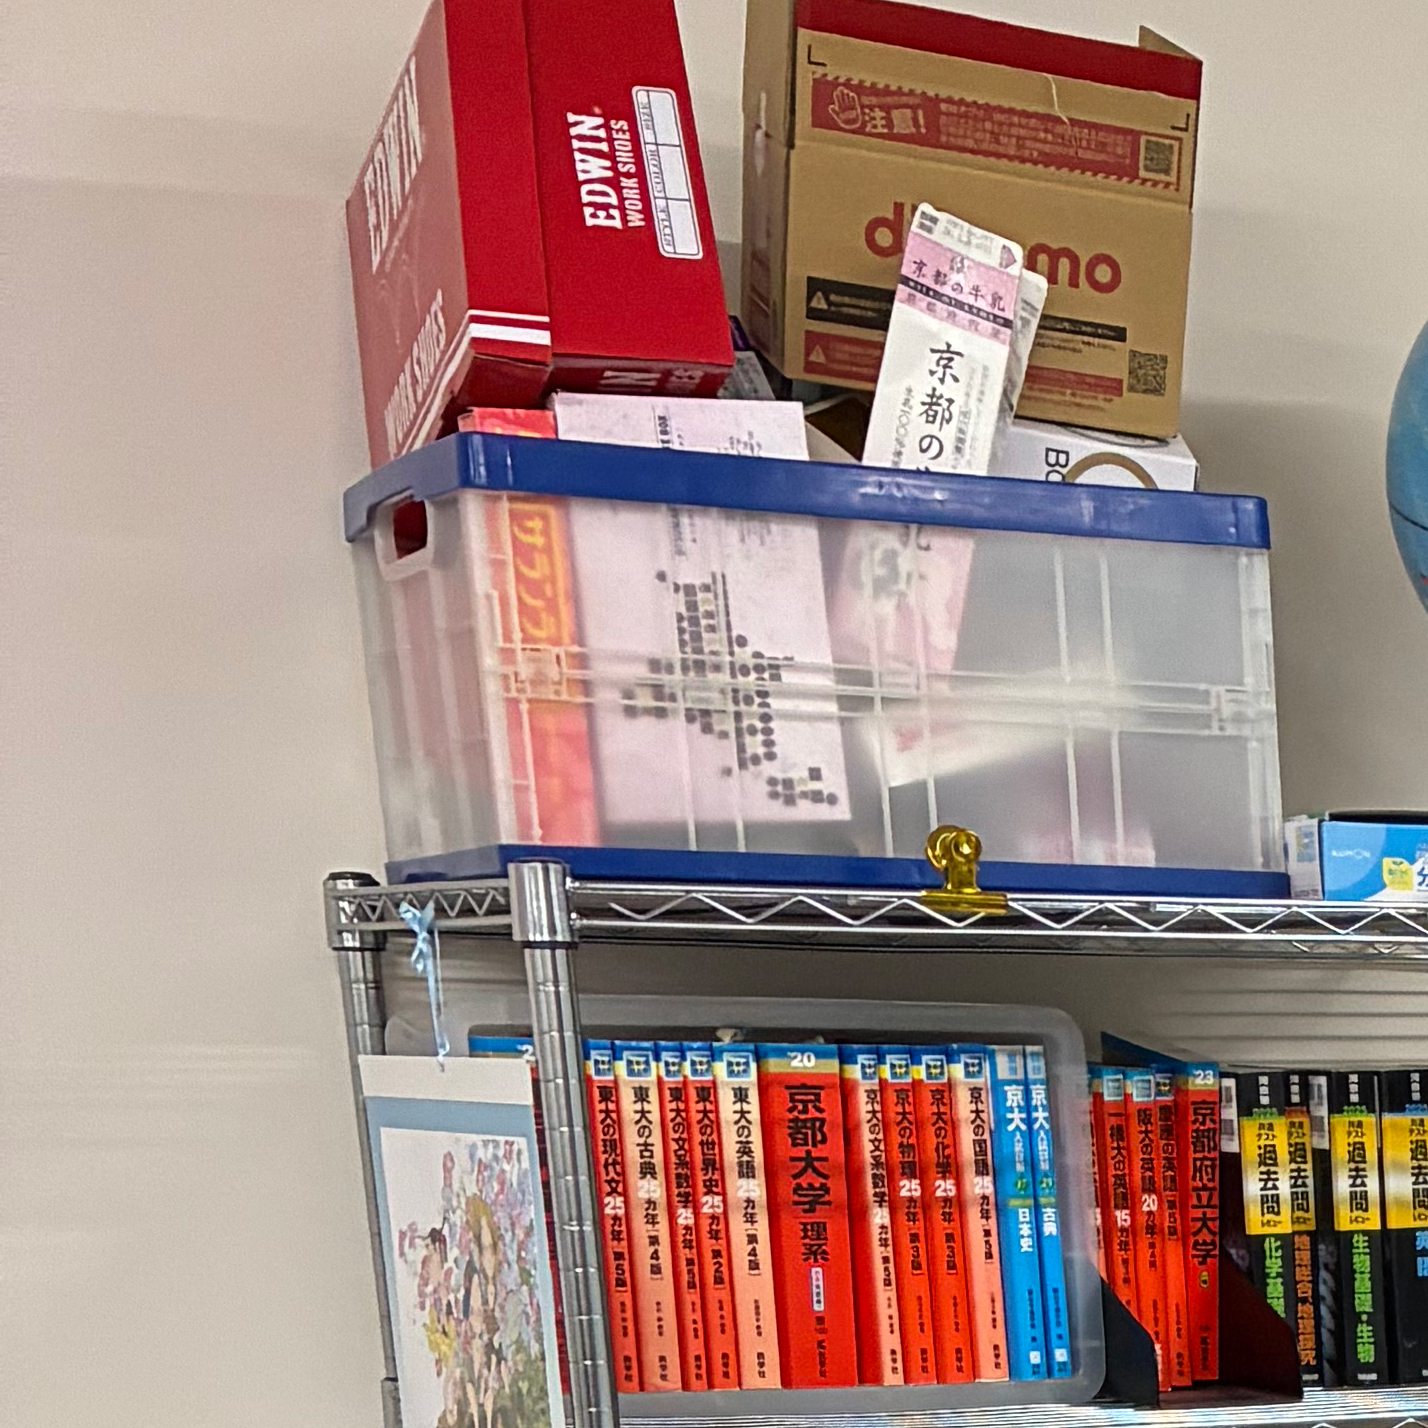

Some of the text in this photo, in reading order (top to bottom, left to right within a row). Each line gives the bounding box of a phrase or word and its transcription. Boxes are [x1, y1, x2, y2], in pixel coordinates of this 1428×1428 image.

[567, 112, 622, 229] EDWIN
[611, 120, 645, 227] WORK SHOES
[912, 259, 1006, 312] 京都の牛乳
[916, 341, 964, 472] 京都の
[784, 1083, 833, 1214] 京都大学
[1191, 1099, 1218, 1267] 京都府立大学
[1257, 1144, 1281, 1217] 過去問
[1288, 1142, 1310, 1215] 過去問
[1347, 1141, 1369, 1215] 過去問
[1018, 1208, 1034, 1253] 日本史
[1042, 1208, 1058, 1236] 古典
